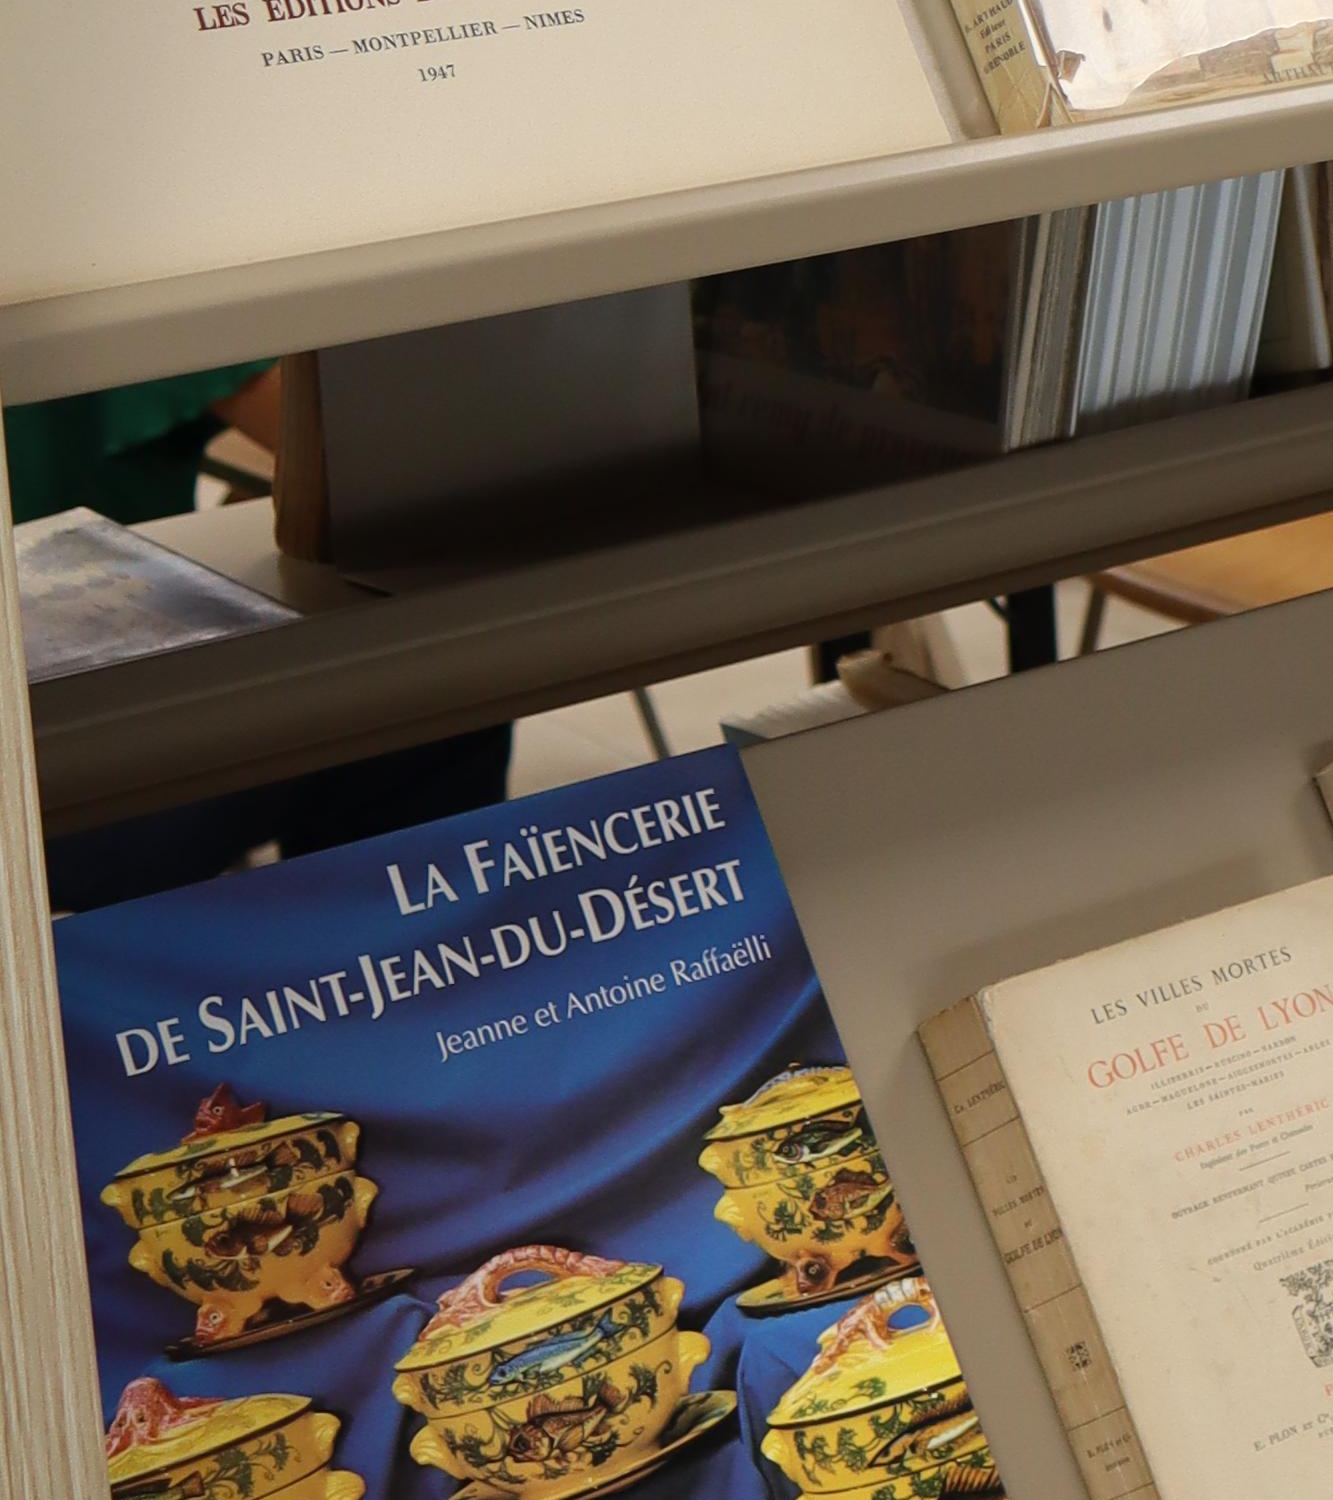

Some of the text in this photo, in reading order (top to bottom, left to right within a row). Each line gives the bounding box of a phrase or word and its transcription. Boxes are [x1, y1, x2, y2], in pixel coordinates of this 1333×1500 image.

[194, 4, 252, 32] LES
[261, 9, 585, 67] PARIS MONTPELLIER NIMES
[417, 63, 457, 82] 1947
[387, 787, 726, 917] LA FAÏENCERIE
[115, 860, 747, 1078] DE SAINT-JEAN-DU-DÉSERT
[435, 933, 774, 1064] Jeanne et Antoine Raffaëlli
[1091, 946, 1292, 1025] LES VILLES MORTES
[1087, 1033, 1190, 1089] GOLFE
[1203, 1015, 1246, 1049] DE
[1173, 1130, 1242, 1162] CHARLES
